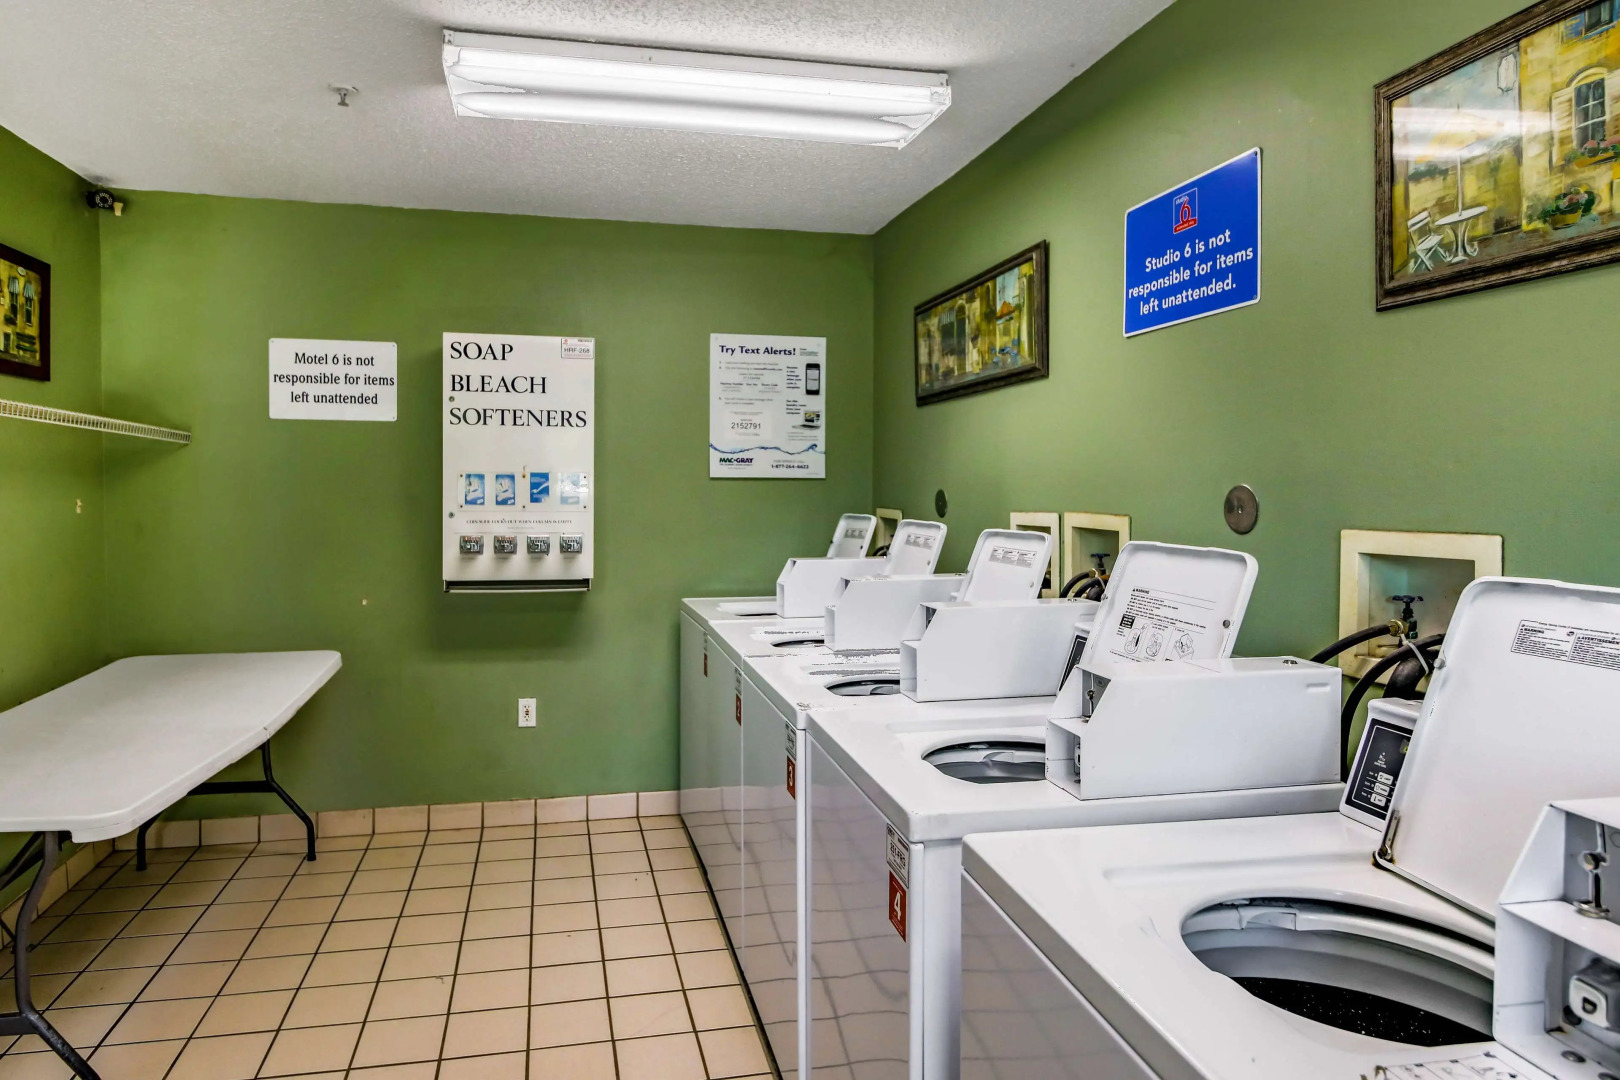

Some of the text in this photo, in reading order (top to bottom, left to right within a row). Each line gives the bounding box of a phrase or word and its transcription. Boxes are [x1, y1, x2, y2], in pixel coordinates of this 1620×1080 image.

[1145, 229, 1231, 272] Studio 6 is not
[1128, 247, 1254, 299] responsible for items
[1140, 273, 1237, 315] left unattended.
[294, 352, 375, 366] Motel 6 is not
[450, 341, 514, 361] SOAP
[719, 345, 736, 356] Try
[738, 346, 760, 355] Text
[762, 347, 796, 356] Alerts!
[273, 372, 395, 386] responsible for items
[450, 374, 547, 394] BLEACH
[290, 391, 378, 405] left unattended
[449, 407, 587, 428] SOFTENERS
[788, 765, 794, 787] 3
[893, 891, 902, 921] 4
